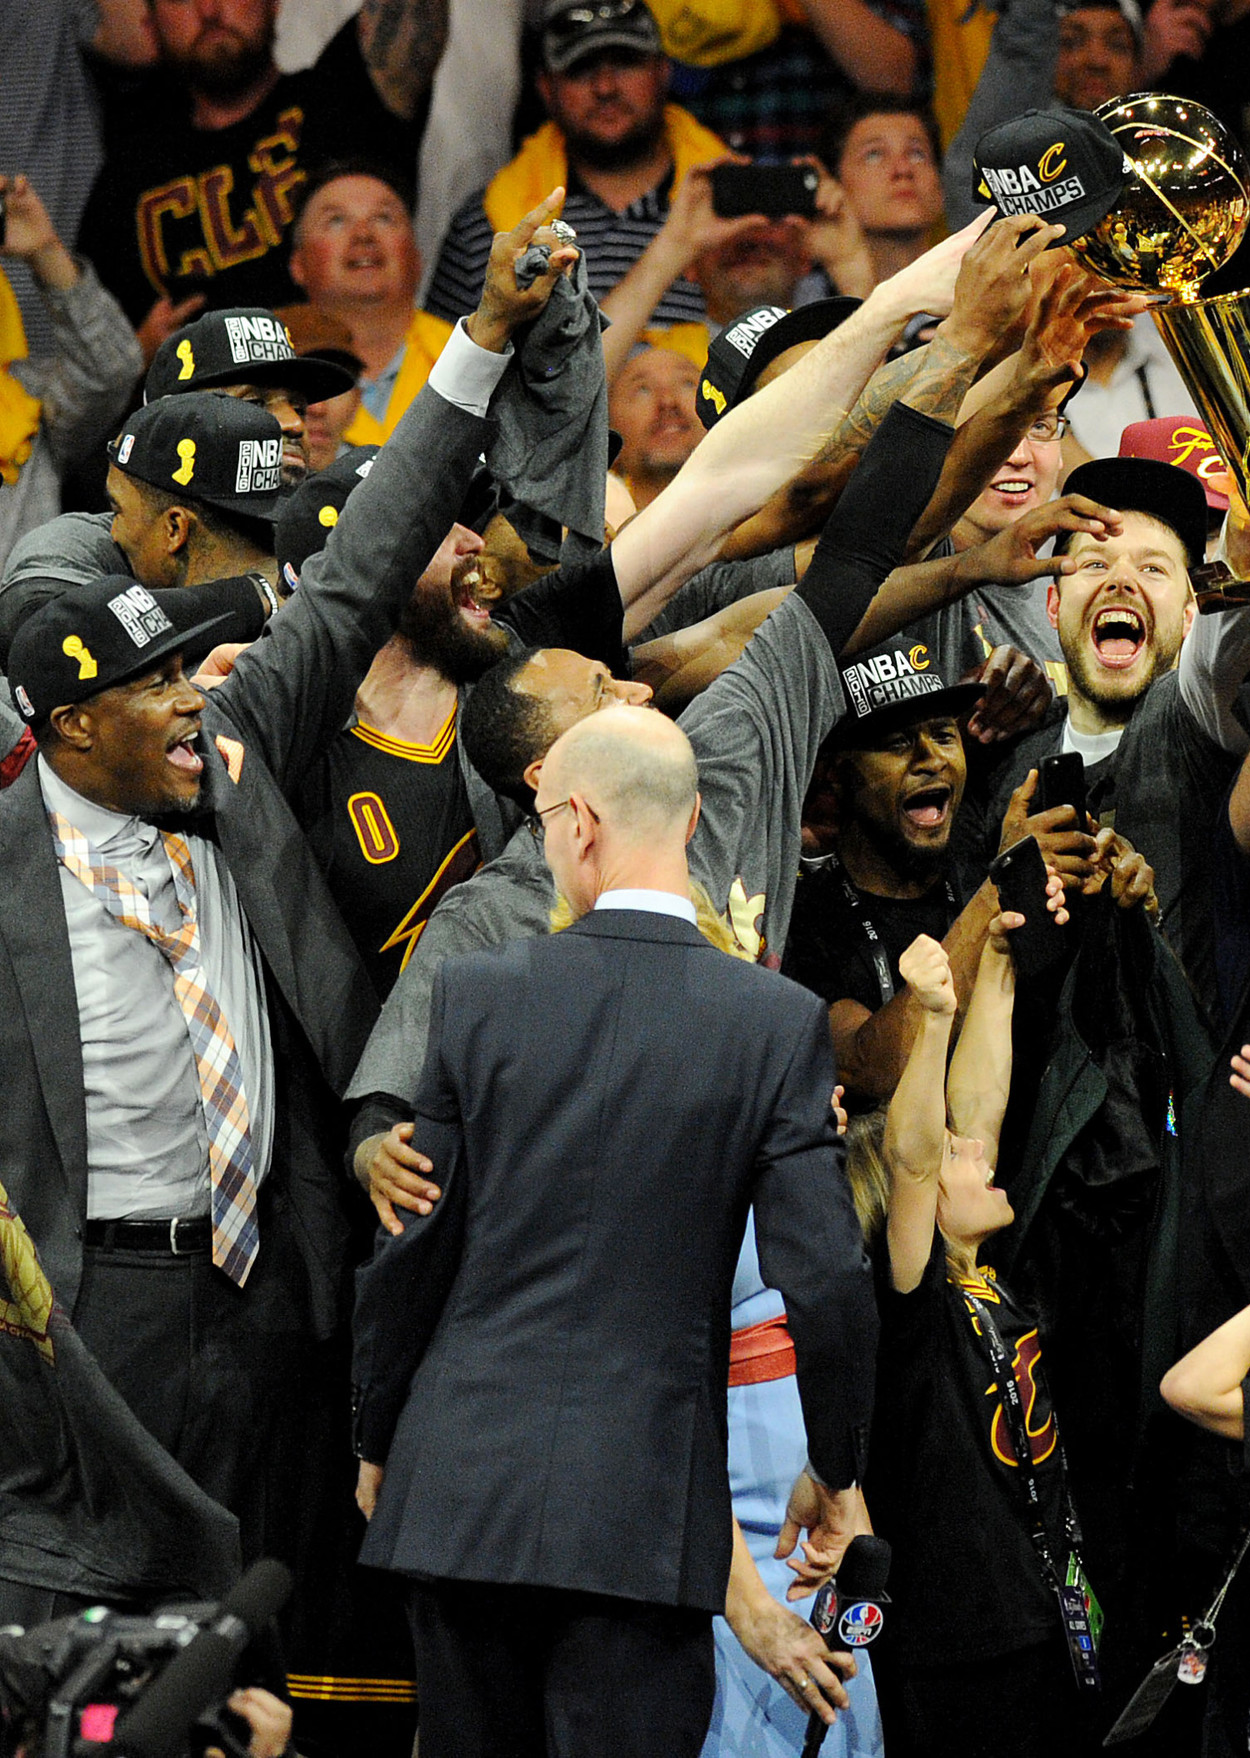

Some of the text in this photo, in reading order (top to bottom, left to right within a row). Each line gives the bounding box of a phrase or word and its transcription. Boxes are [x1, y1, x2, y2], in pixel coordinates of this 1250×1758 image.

[991, 165, 1042, 196] NBA
[1004, 178, 1082, 216] CHAMPS
[241, 316, 290, 345] NBA
[238, 443, 252, 491] 2016
[111, 599, 149, 645] 2016
[856, 650, 915, 688] NBA
[845, 668, 869, 714] 2016
[869, 674, 942, 708] CHAMPS
[347, 791, 400, 864] 0
[1006, 1379, 1019, 1405] 2016
